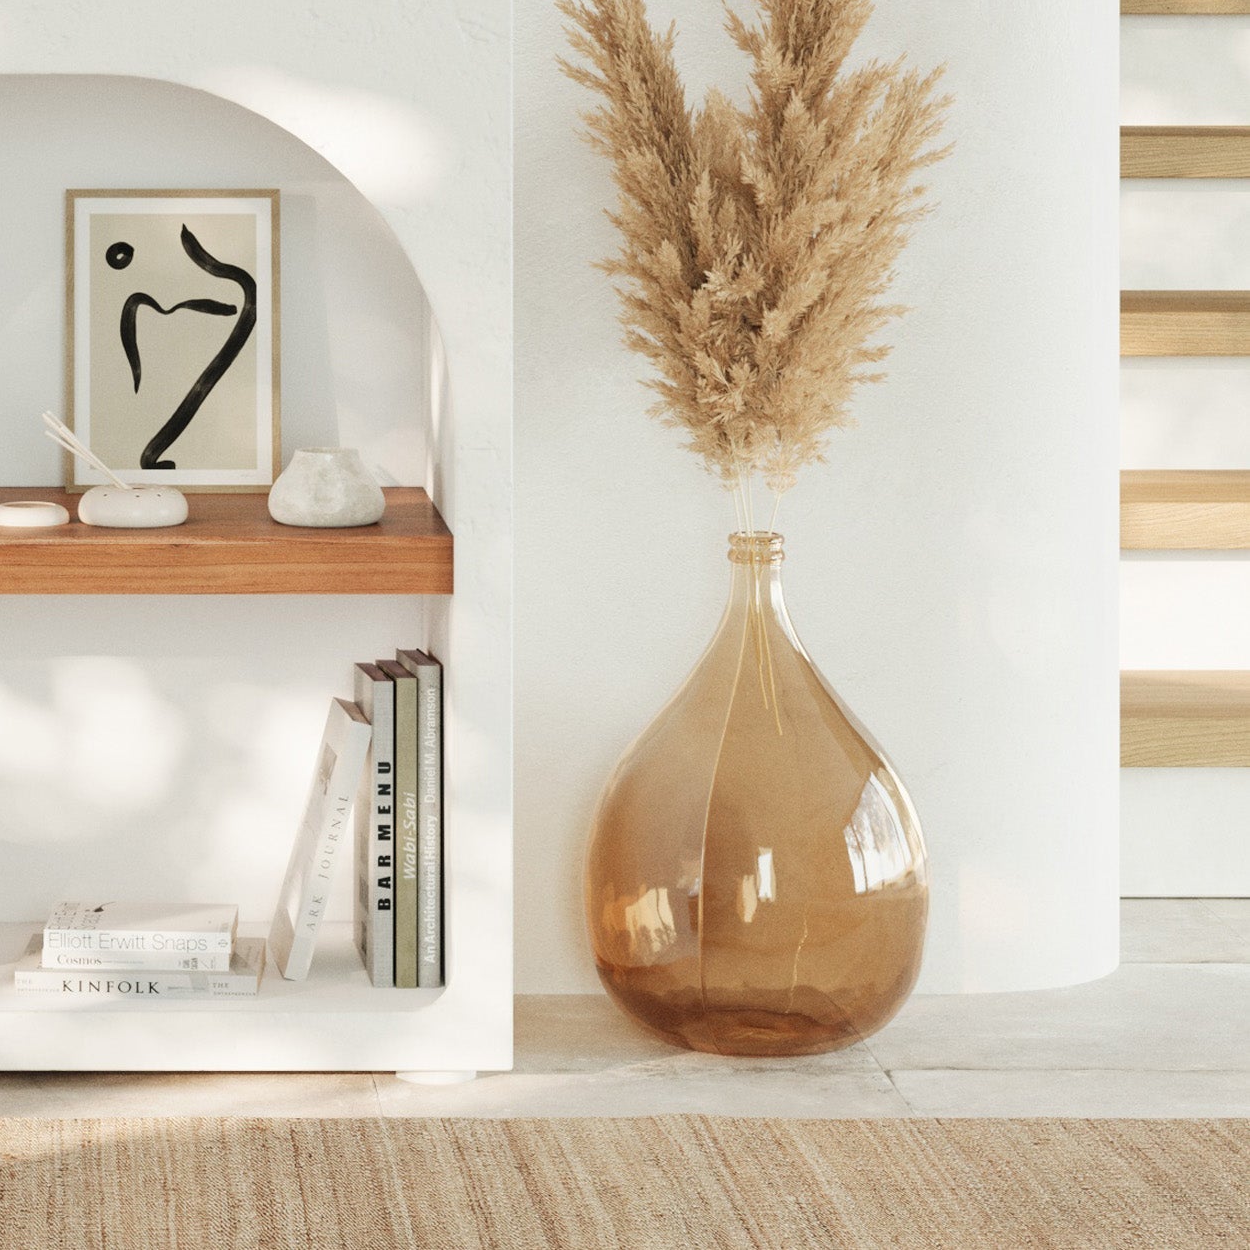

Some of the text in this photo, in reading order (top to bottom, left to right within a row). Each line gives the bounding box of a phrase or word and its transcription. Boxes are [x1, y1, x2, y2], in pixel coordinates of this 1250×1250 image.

[424, 688, 437, 747] Abramson
[423, 767, 436, 803] Daniel
[403, 791, 417, 880] Wabi-Sabi
[424, 815, 438, 859] History
[306, 795, 349, 931] ARK JOURNAL
[424, 861, 436, 942] Architectural
[48, 932, 208, 953] Elliott Erwitt Snaps
[57, 954, 102, 965] Cosmos
[424, 945, 436, 963] An
[62, 980, 160, 994] KINFOLK
